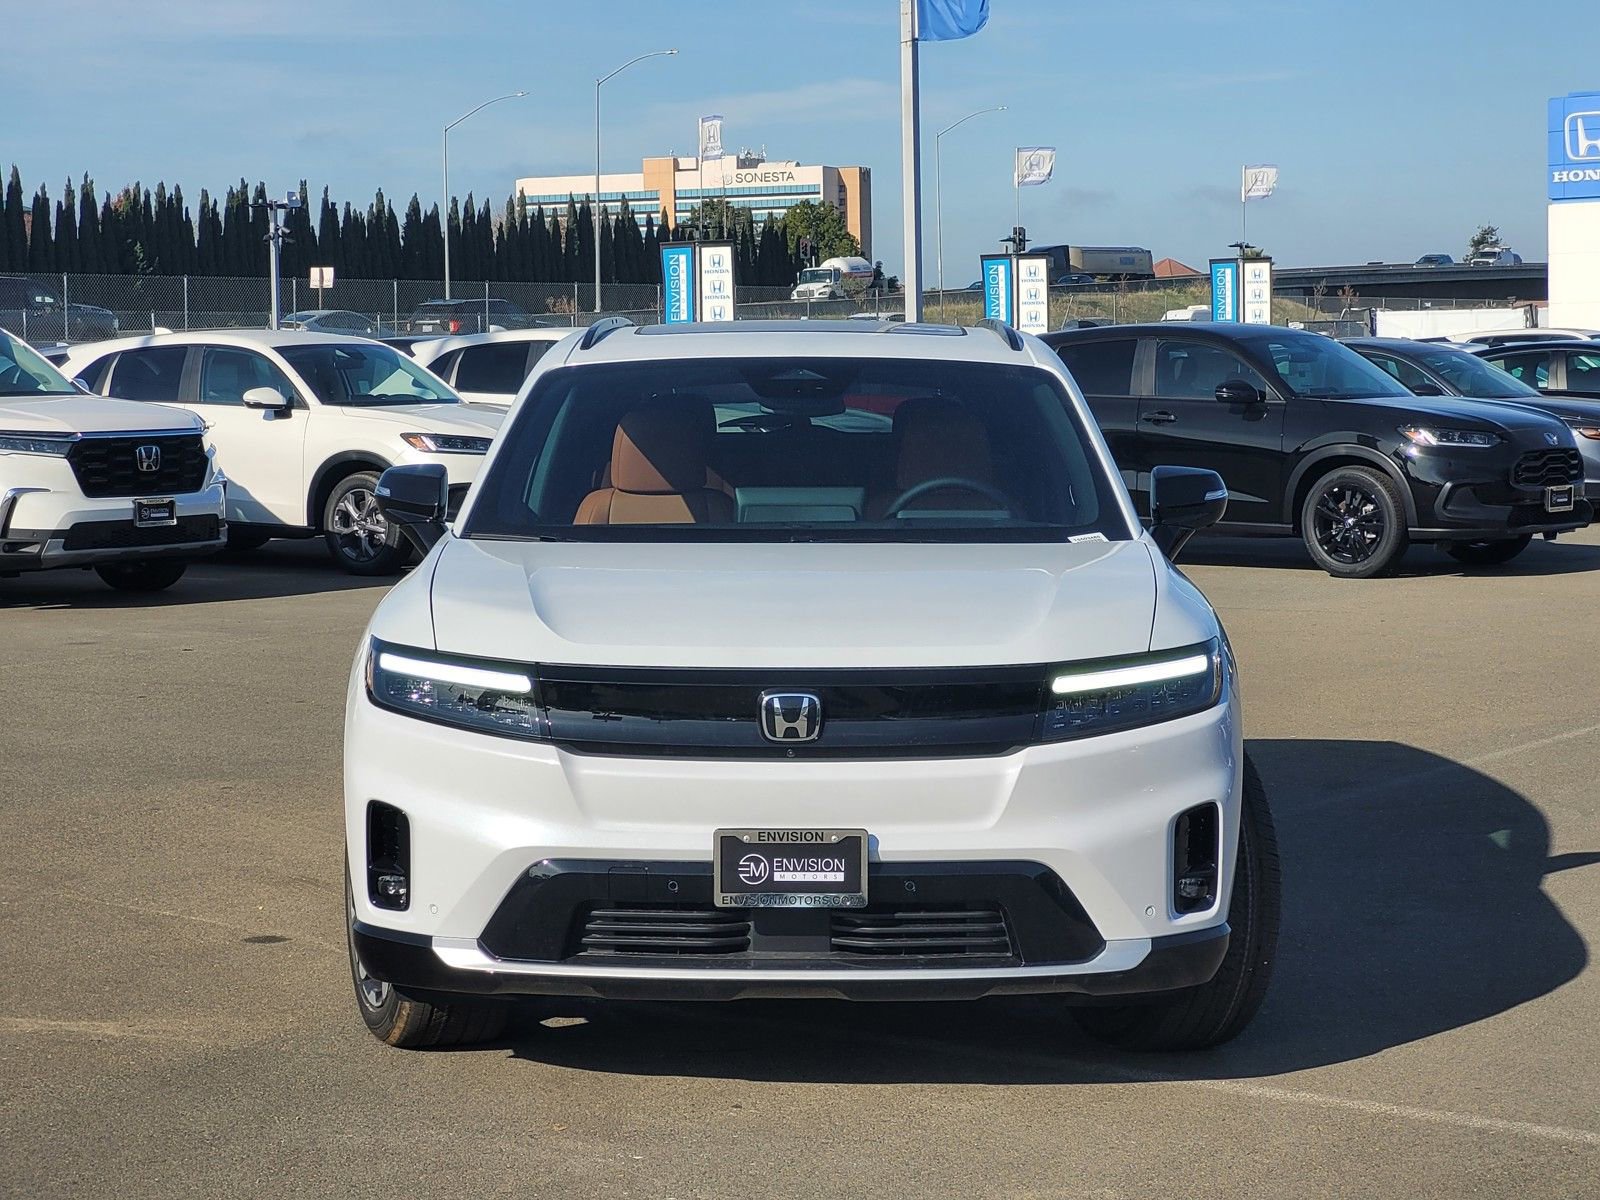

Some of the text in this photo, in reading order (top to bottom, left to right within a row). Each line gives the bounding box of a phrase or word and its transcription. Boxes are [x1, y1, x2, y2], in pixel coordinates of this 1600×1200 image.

[735, 171, 795, 184] SONESTA
[669, 254, 680, 321] ENVISION
[1217, 268, 1226, 320] ENVISION
[757, 831, 824, 842] ENVISION
[773, 858, 845, 872] ENVISION
